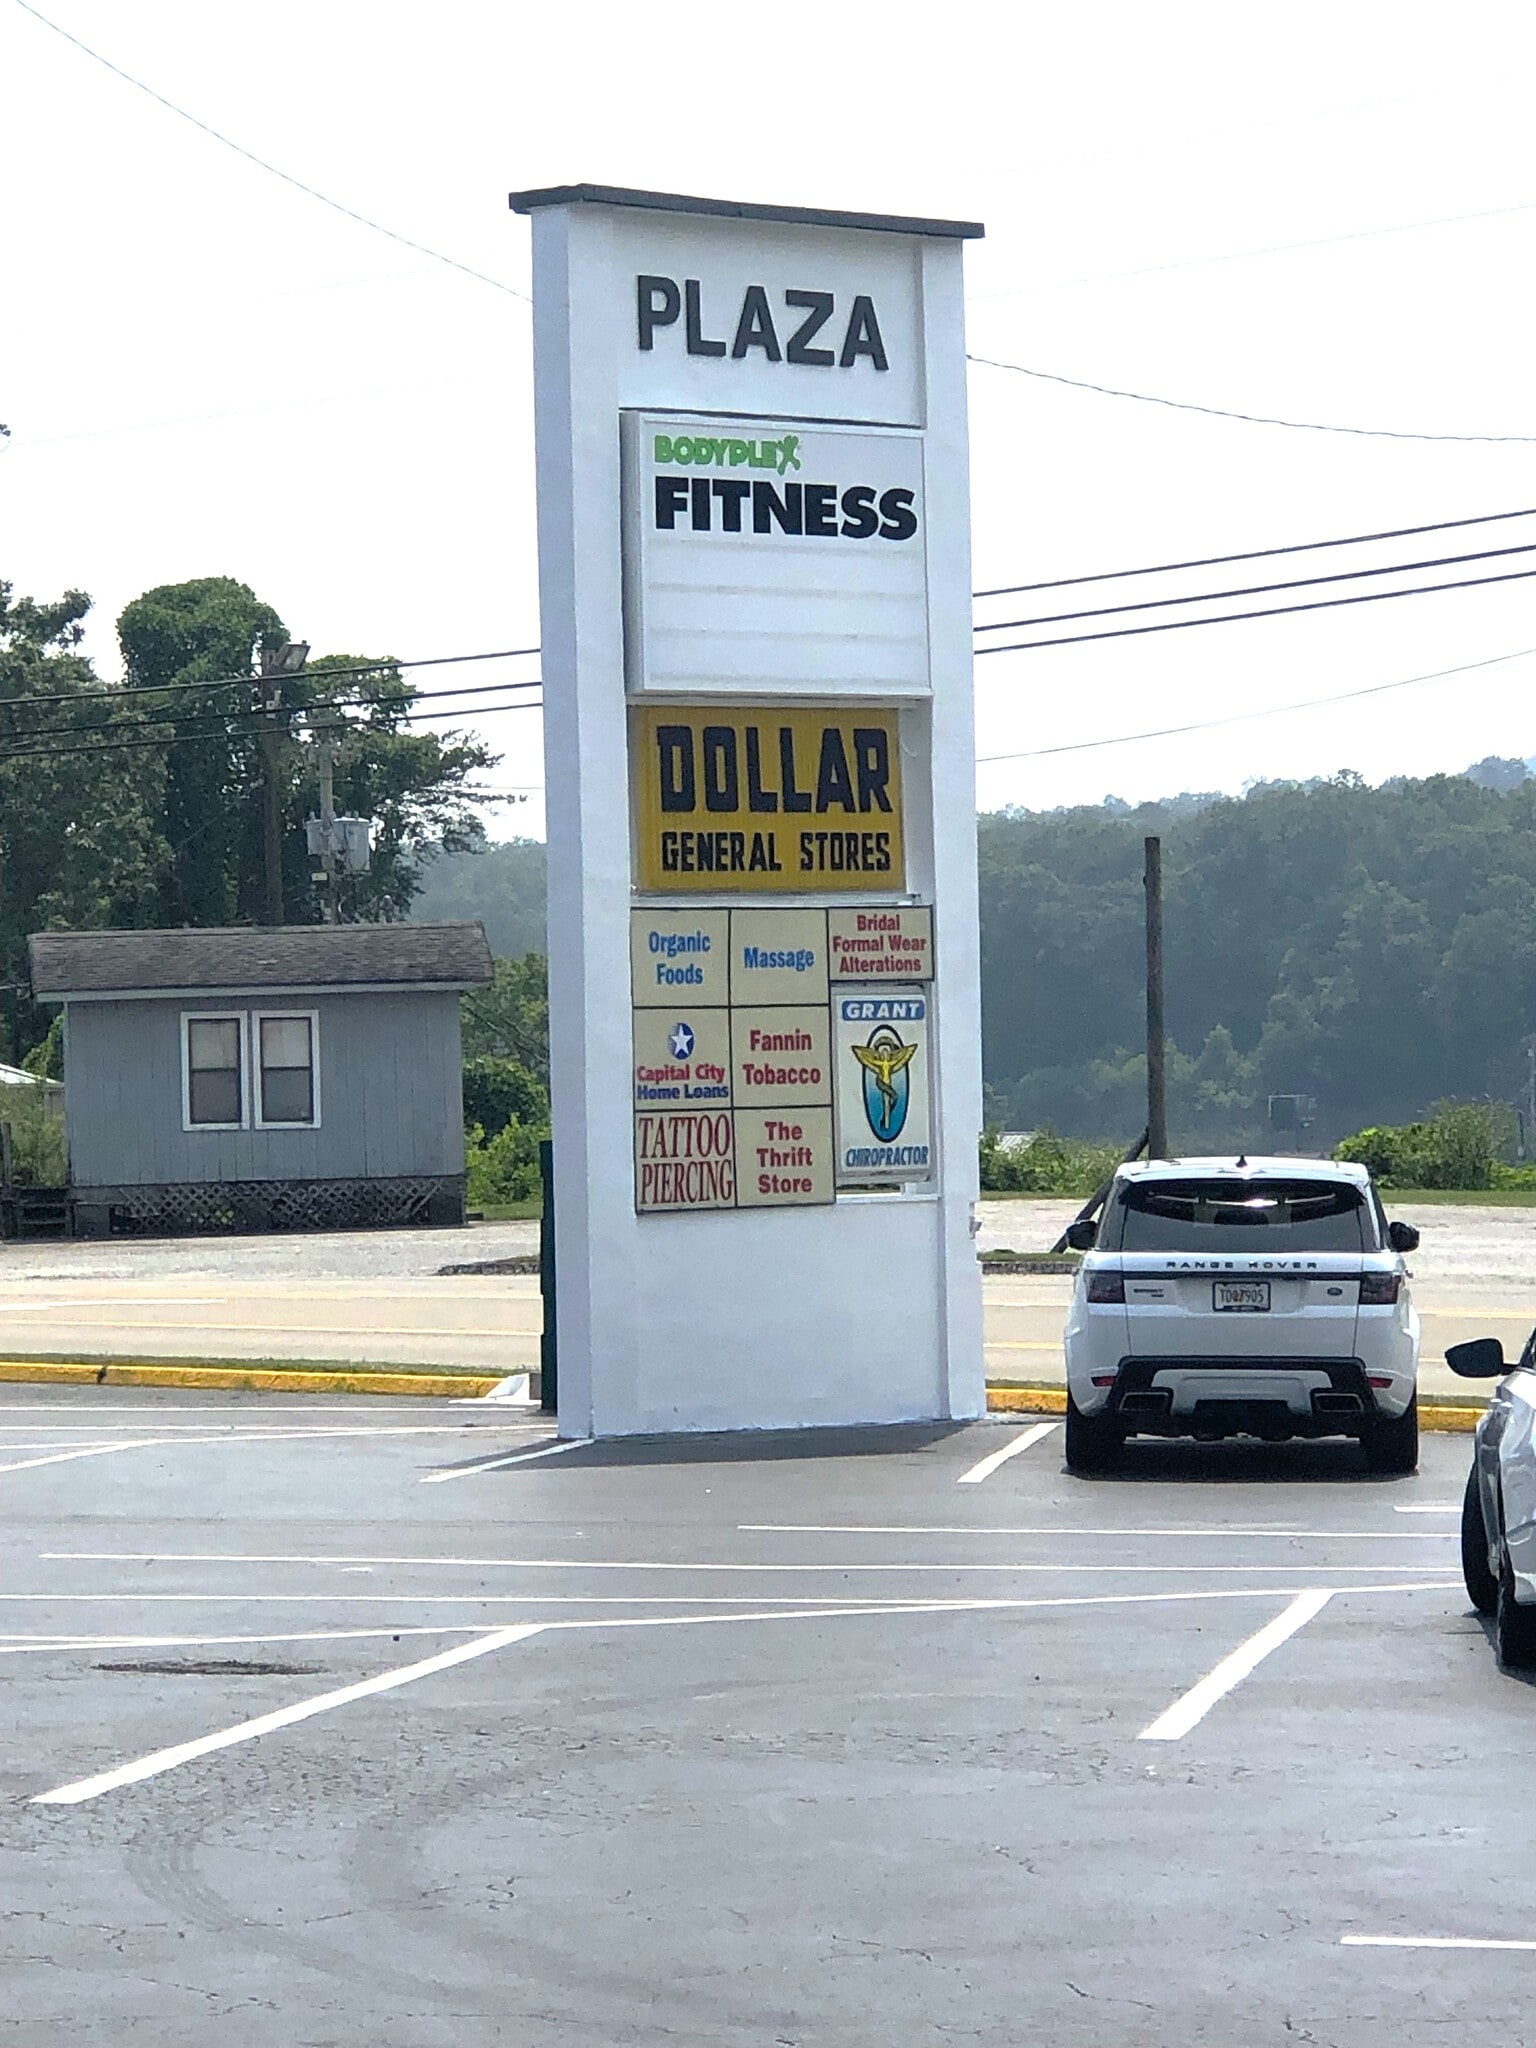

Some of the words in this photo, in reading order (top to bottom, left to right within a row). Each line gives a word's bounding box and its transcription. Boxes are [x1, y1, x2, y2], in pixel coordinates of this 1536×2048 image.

[637, 274, 889, 371] PLAZA
[654, 435, 801, 476] BODYPLEX
[655, 476, 918, 540] FITNESS
[656, 726, 893, 813] DOLLAR
[662, 831, 782, 871] GENERAL
[800, 832, 891, 871] STORES
[857, 914, 900, 931] Bridal
[649, 930, 711, 957] Organic
[832, 935, 884, 952] Formal
[888, 935, 927, 951] Wear
[744, 946, 815, 972] Massage
[839, 955, 922, 973] Alterations
[656, 963, 704, 985] Foods
[846, 1003, 920, 1018] GRANT
[750, 1028, 812, 1051] Fannin
[637, 1064, 690, 1085] Capital
[695, 1062, 726, 1084] City
[742, 1064, 821, 1085] Tobacco
[637, 1085, 680, 1100] Home
[684, 1083, 729, 1099] Loans
[638, 1114, 731, 1159] TATTOO
[764, 1121, 803, 1141] The
[756, 1147, 813, 1168] Thrift
[845, 1146, 929, 1168] CHIROPRACTOR
[640, 1159, 733, 1204] PIERCING
[758, 1174, 813, 1193] Store
